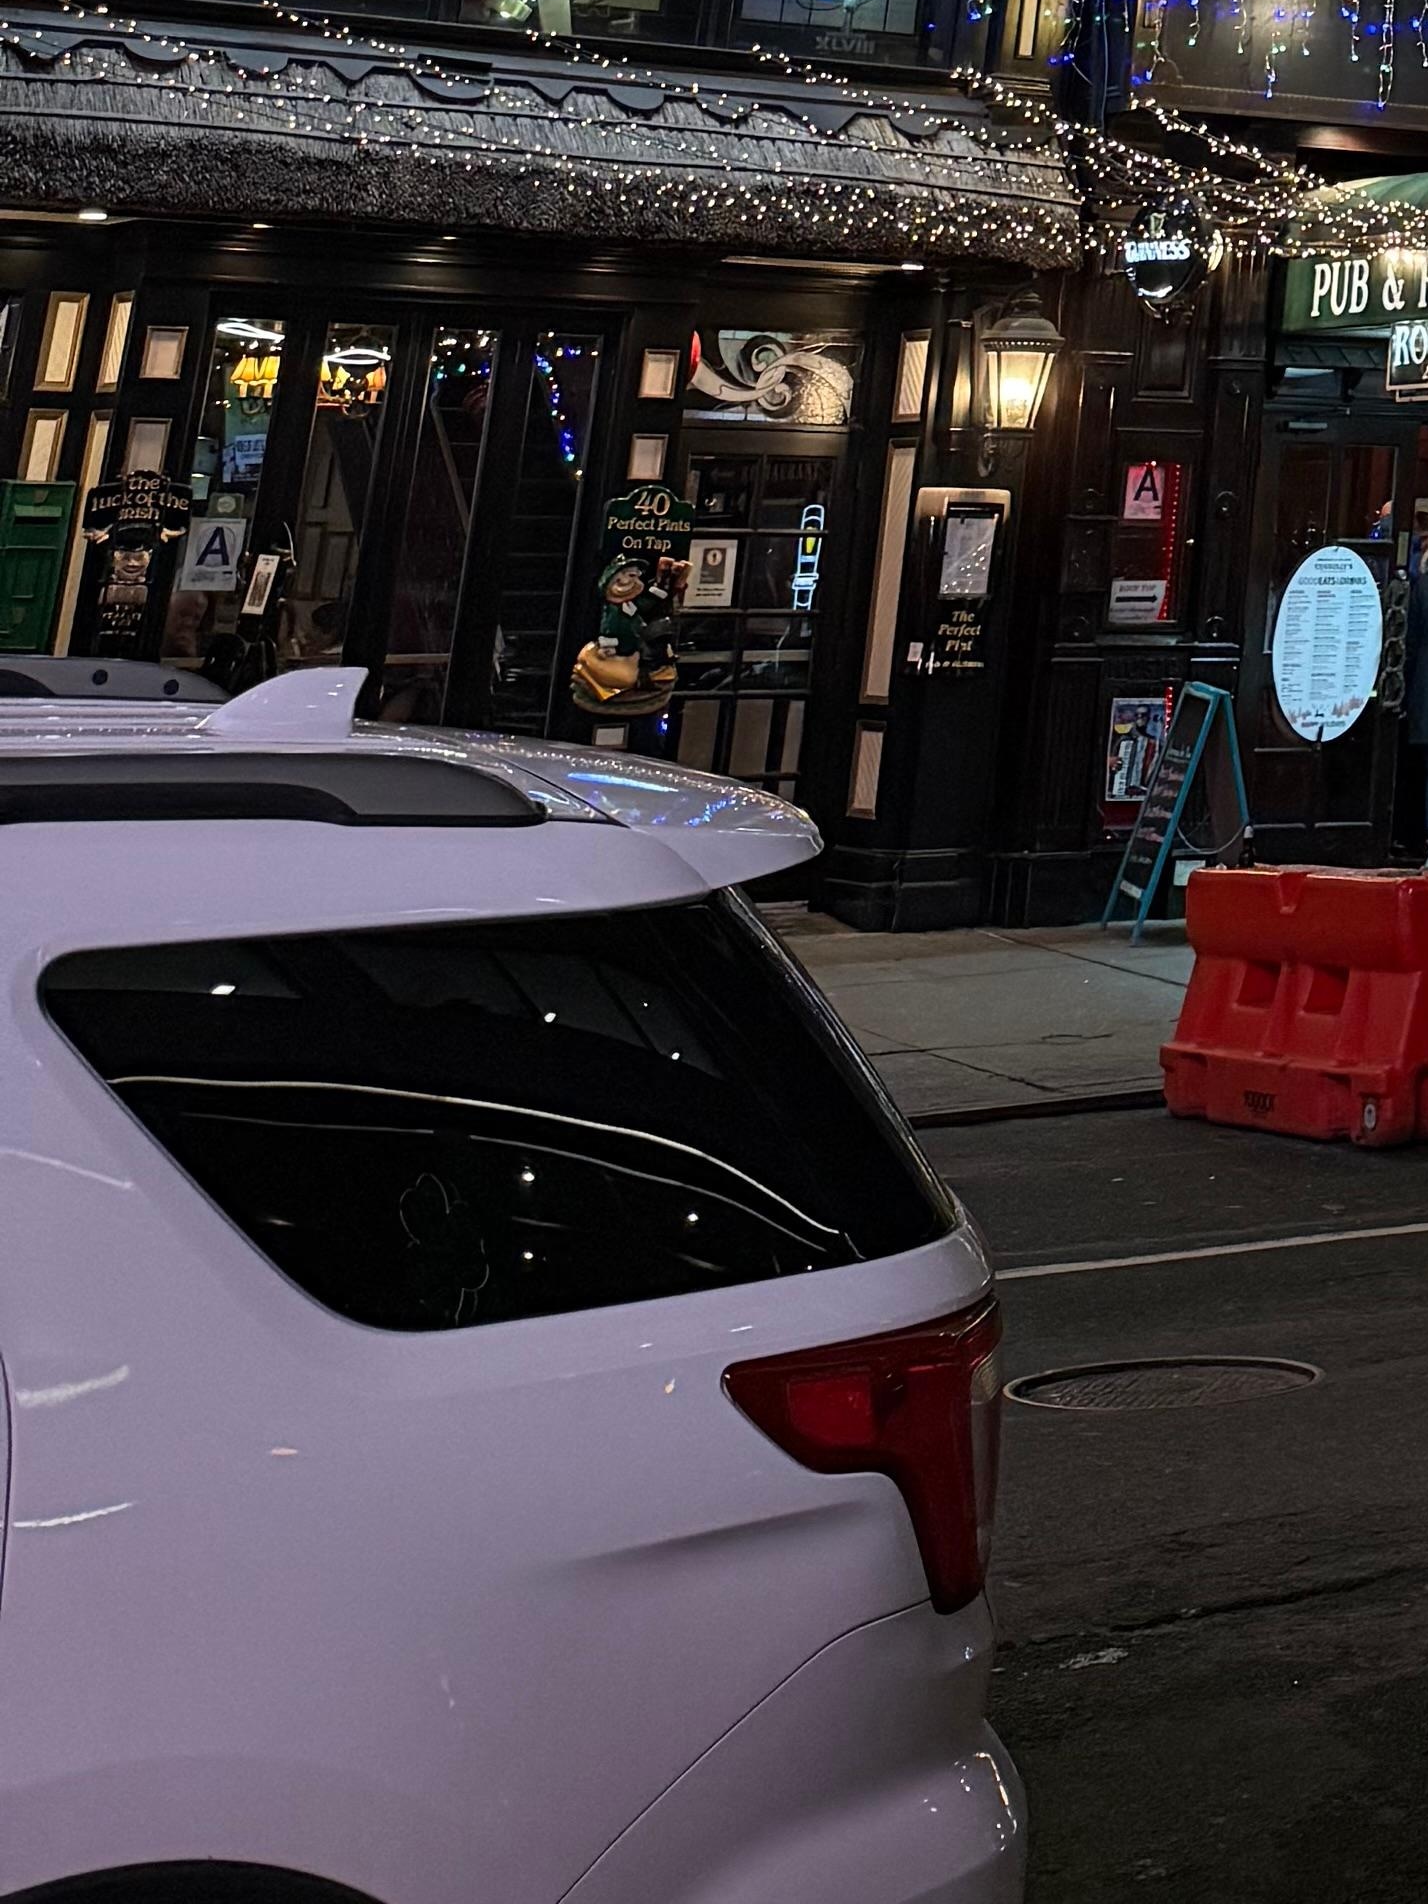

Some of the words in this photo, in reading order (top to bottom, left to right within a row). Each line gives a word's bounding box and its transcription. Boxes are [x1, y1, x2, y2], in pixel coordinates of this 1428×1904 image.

[1311, 259, 1369, 317] PUB
[1382, 269, 1405, 311] &
[1134, 469, 1158, 502] A
[634, 491, 671, 517] 40
[608, 516, 655, 532] Perfect
[657, 517, 692, 533] Pints
[196, 526, 229, 566] A
[622, 535, 643, 550] On
[645, 536, 672, 552] Tap
[951, 611, 975, 623] The
[938, 624, 982, 637] Perfect
